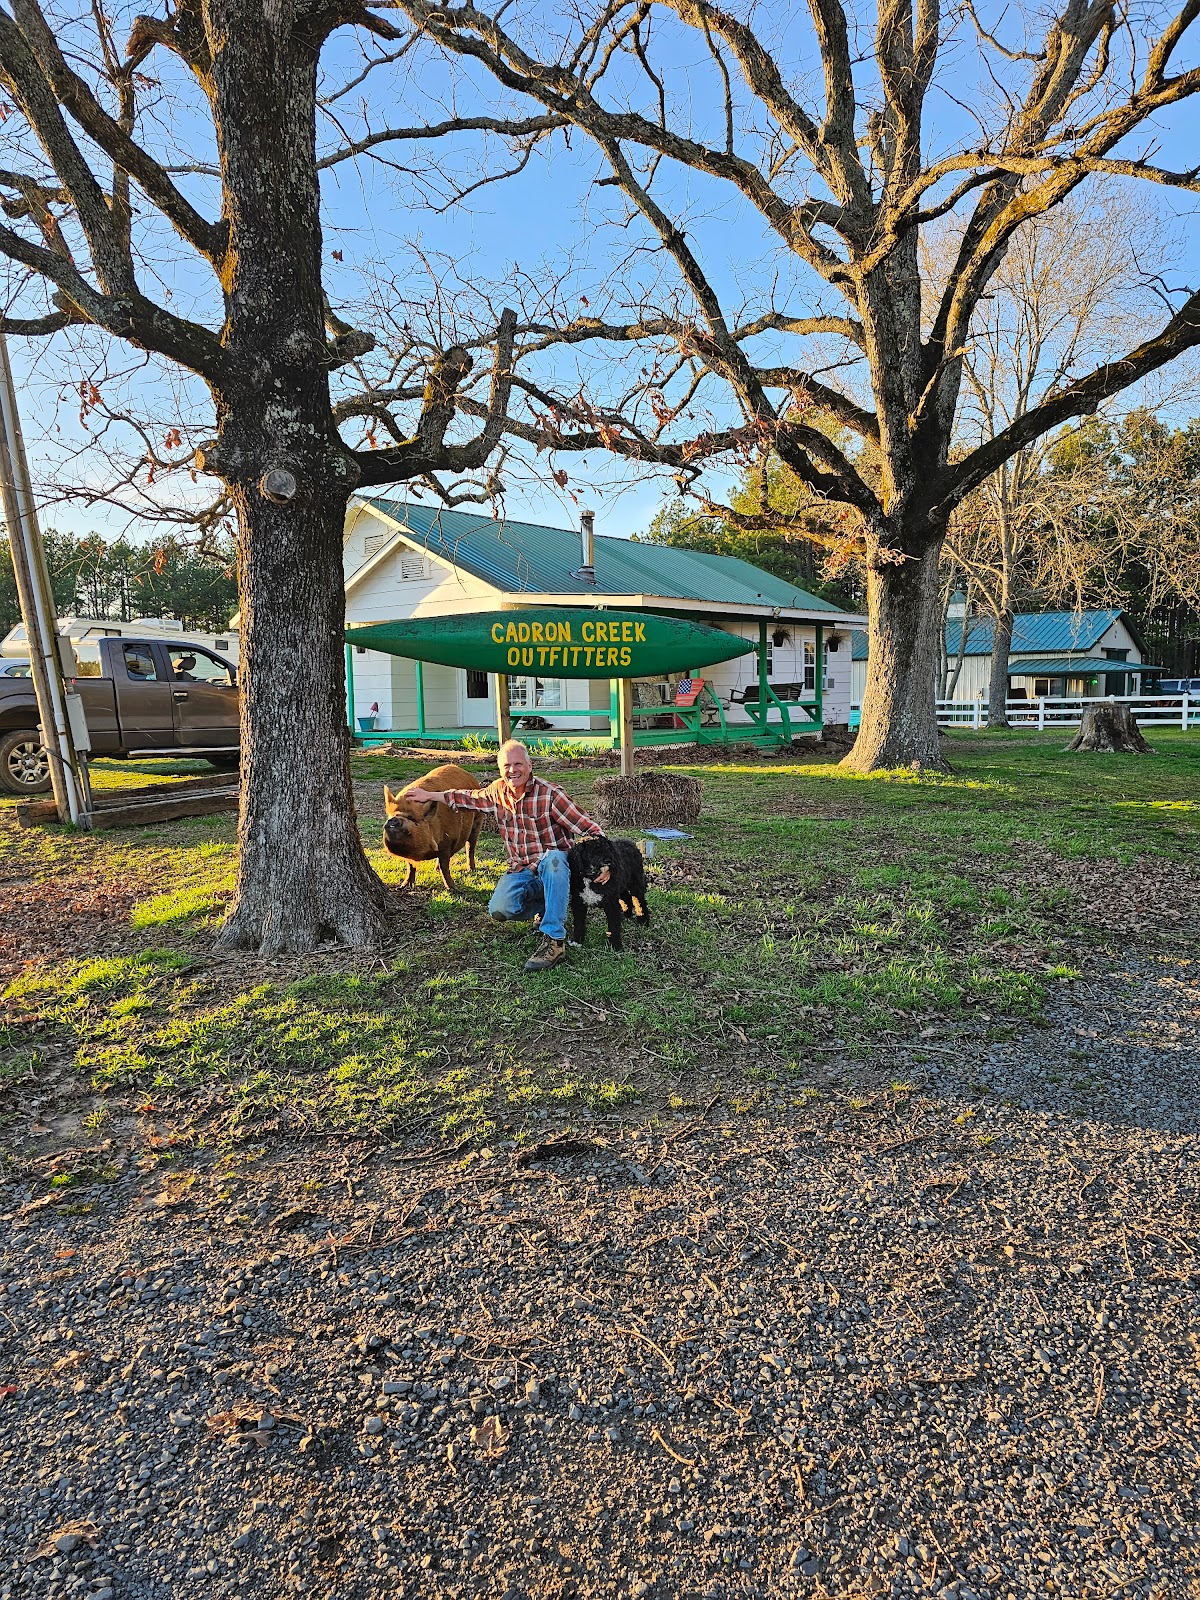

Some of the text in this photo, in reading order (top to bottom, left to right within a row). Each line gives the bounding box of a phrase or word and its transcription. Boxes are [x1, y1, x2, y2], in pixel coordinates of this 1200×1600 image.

[491, 621, 646, 643] CADRON CREEK
[507, 646, 632, 667] OUTFITTERS
